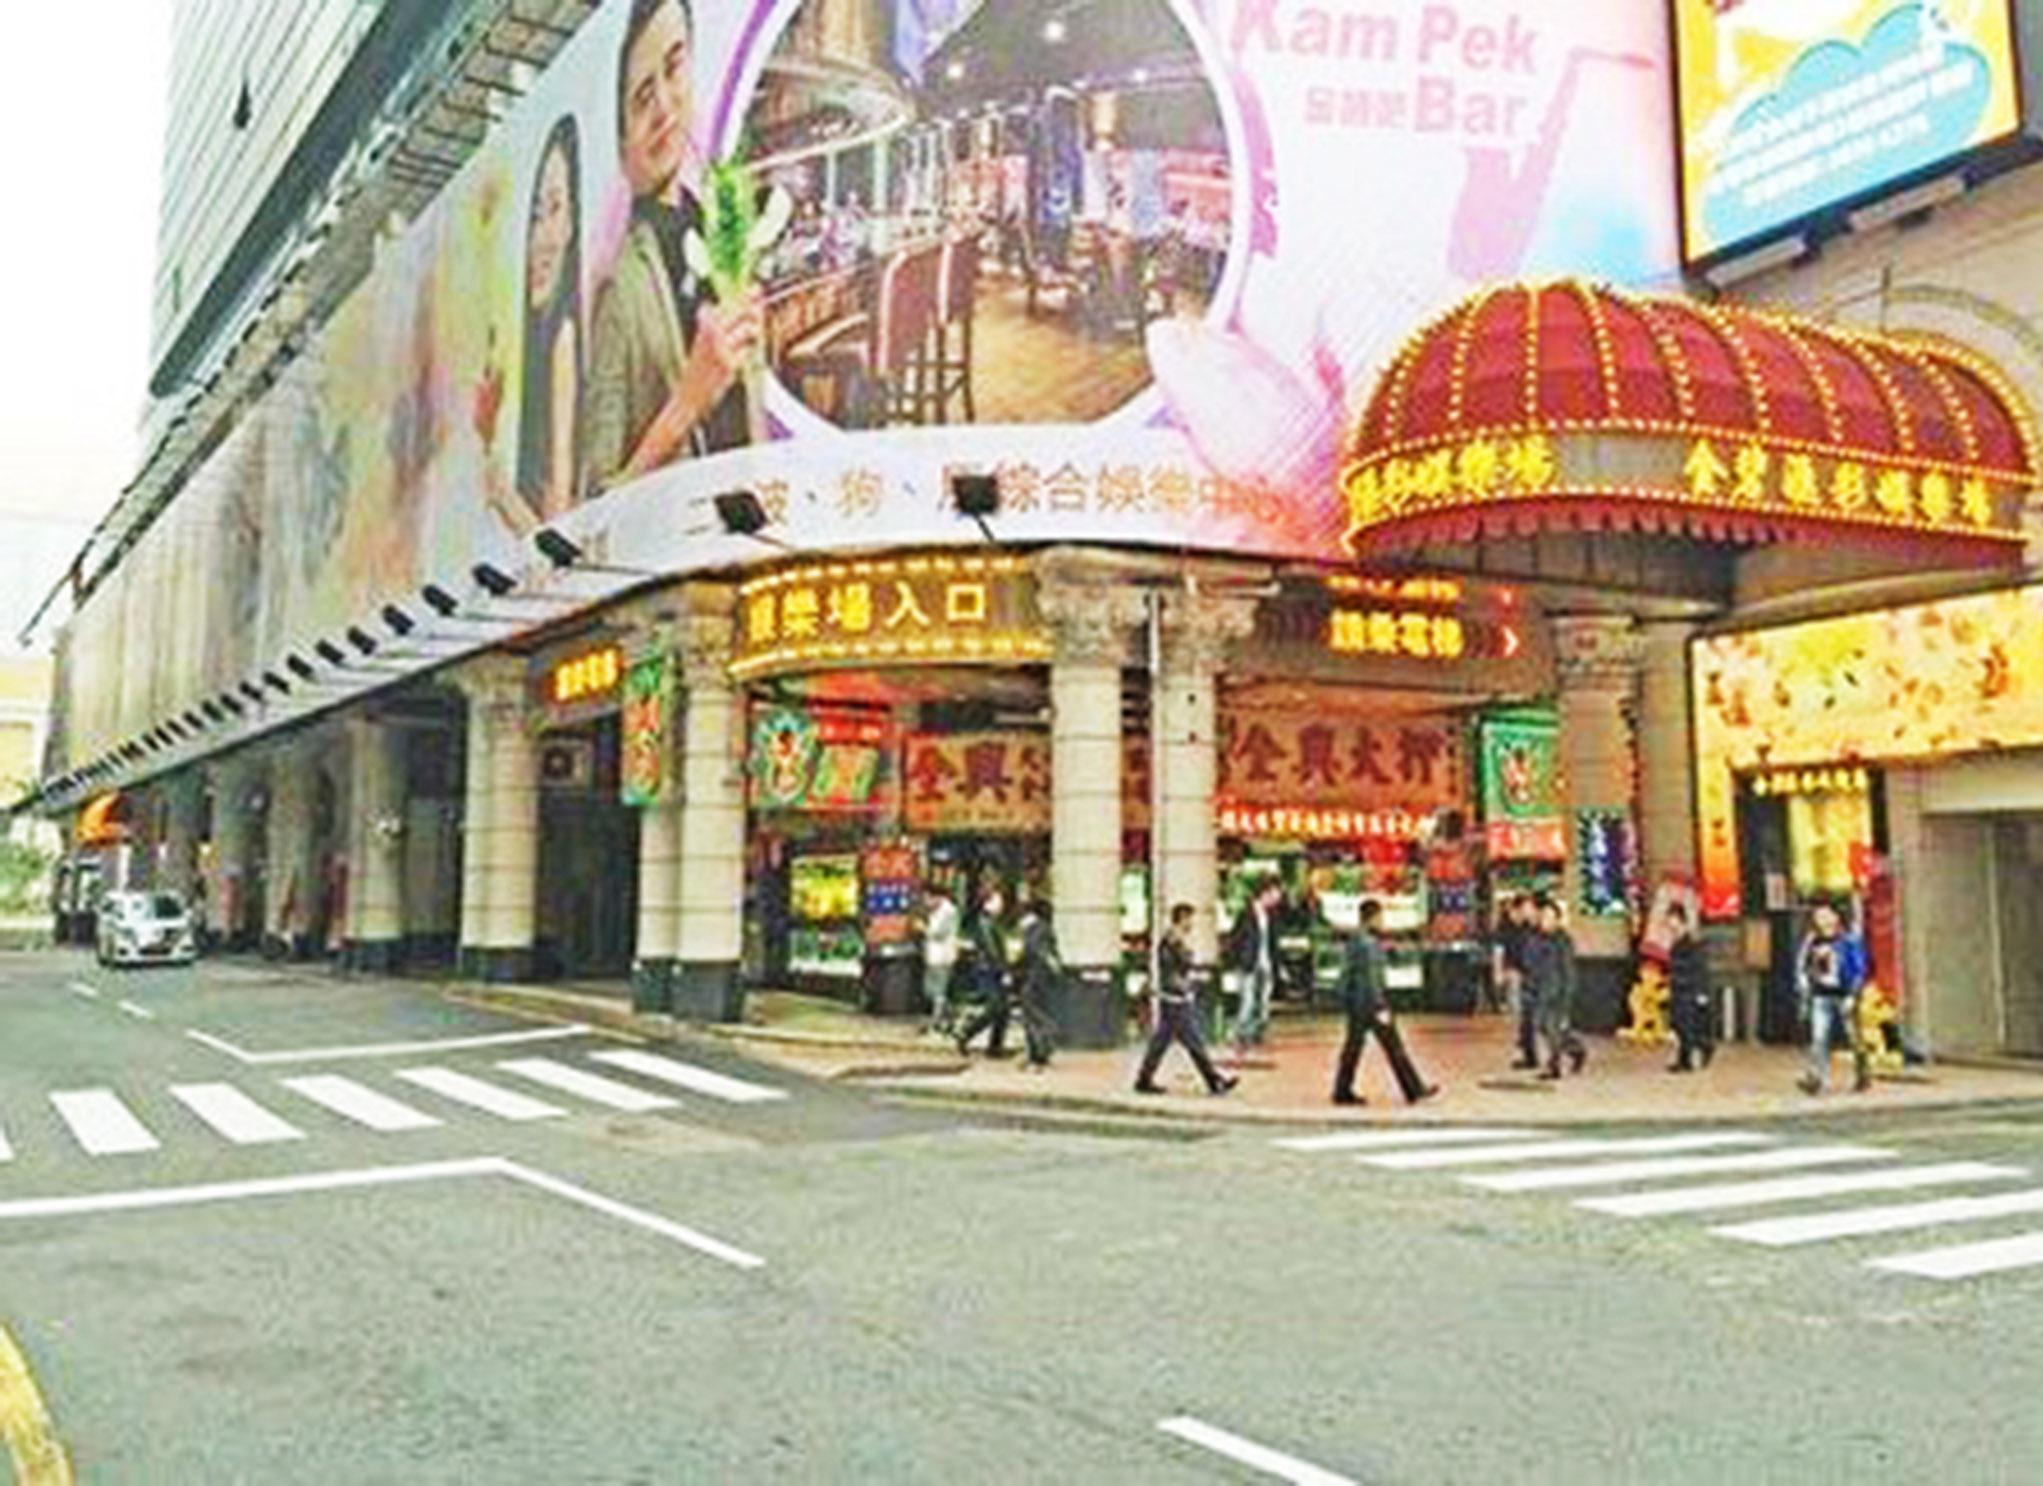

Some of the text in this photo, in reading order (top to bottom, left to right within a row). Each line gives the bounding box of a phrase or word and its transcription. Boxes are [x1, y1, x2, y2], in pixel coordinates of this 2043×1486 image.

[1230, 0, 1538, 74] Kam Pek
[1414, 75, 1528, 136] Bar
